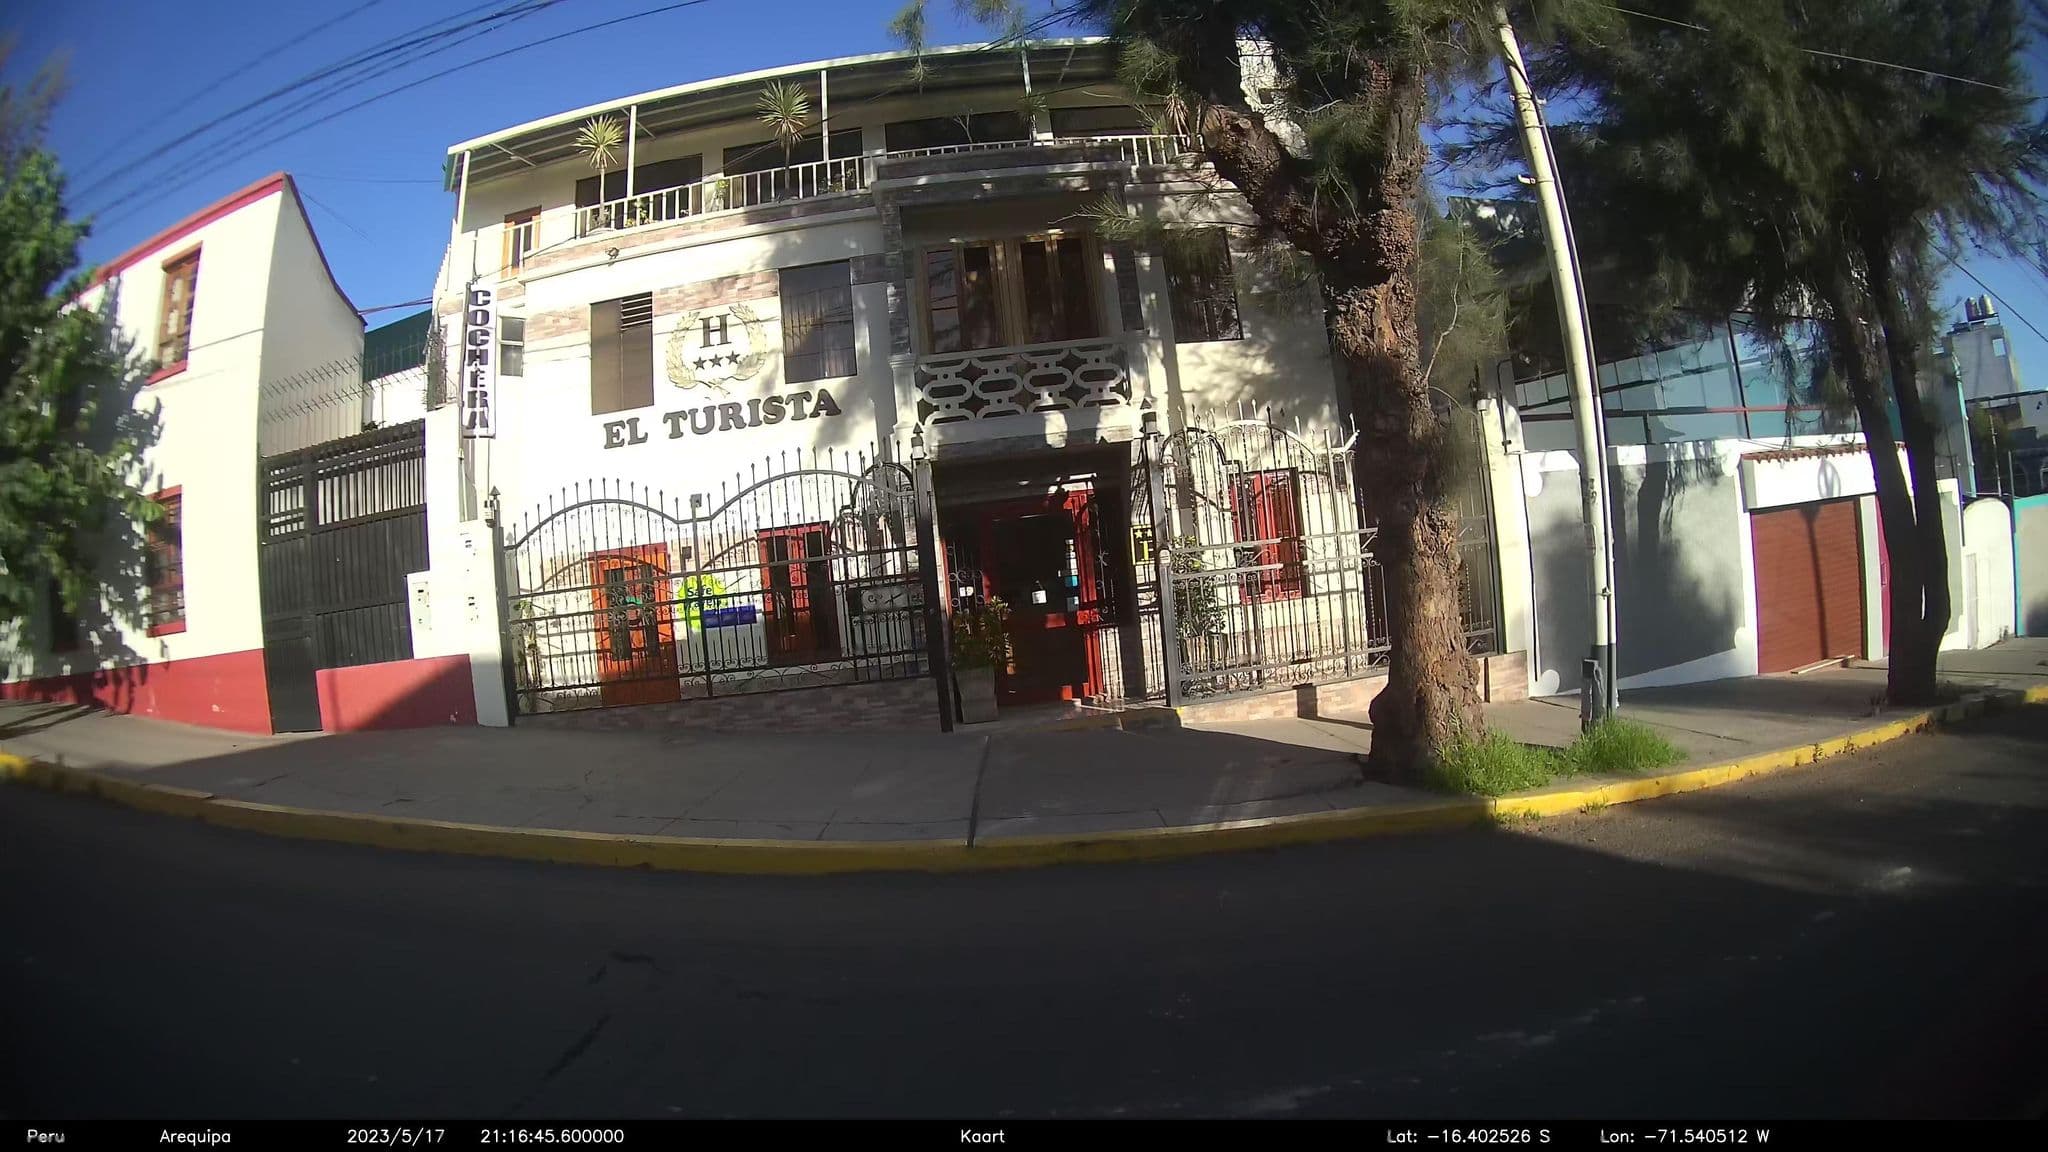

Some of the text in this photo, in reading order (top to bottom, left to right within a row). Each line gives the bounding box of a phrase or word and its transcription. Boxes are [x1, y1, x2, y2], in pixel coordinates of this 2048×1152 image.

[467, 290, 491, 429] COCHERA
[698, 313, 732, 349] H
[603, 388, 842, 449] EL TURISTA
